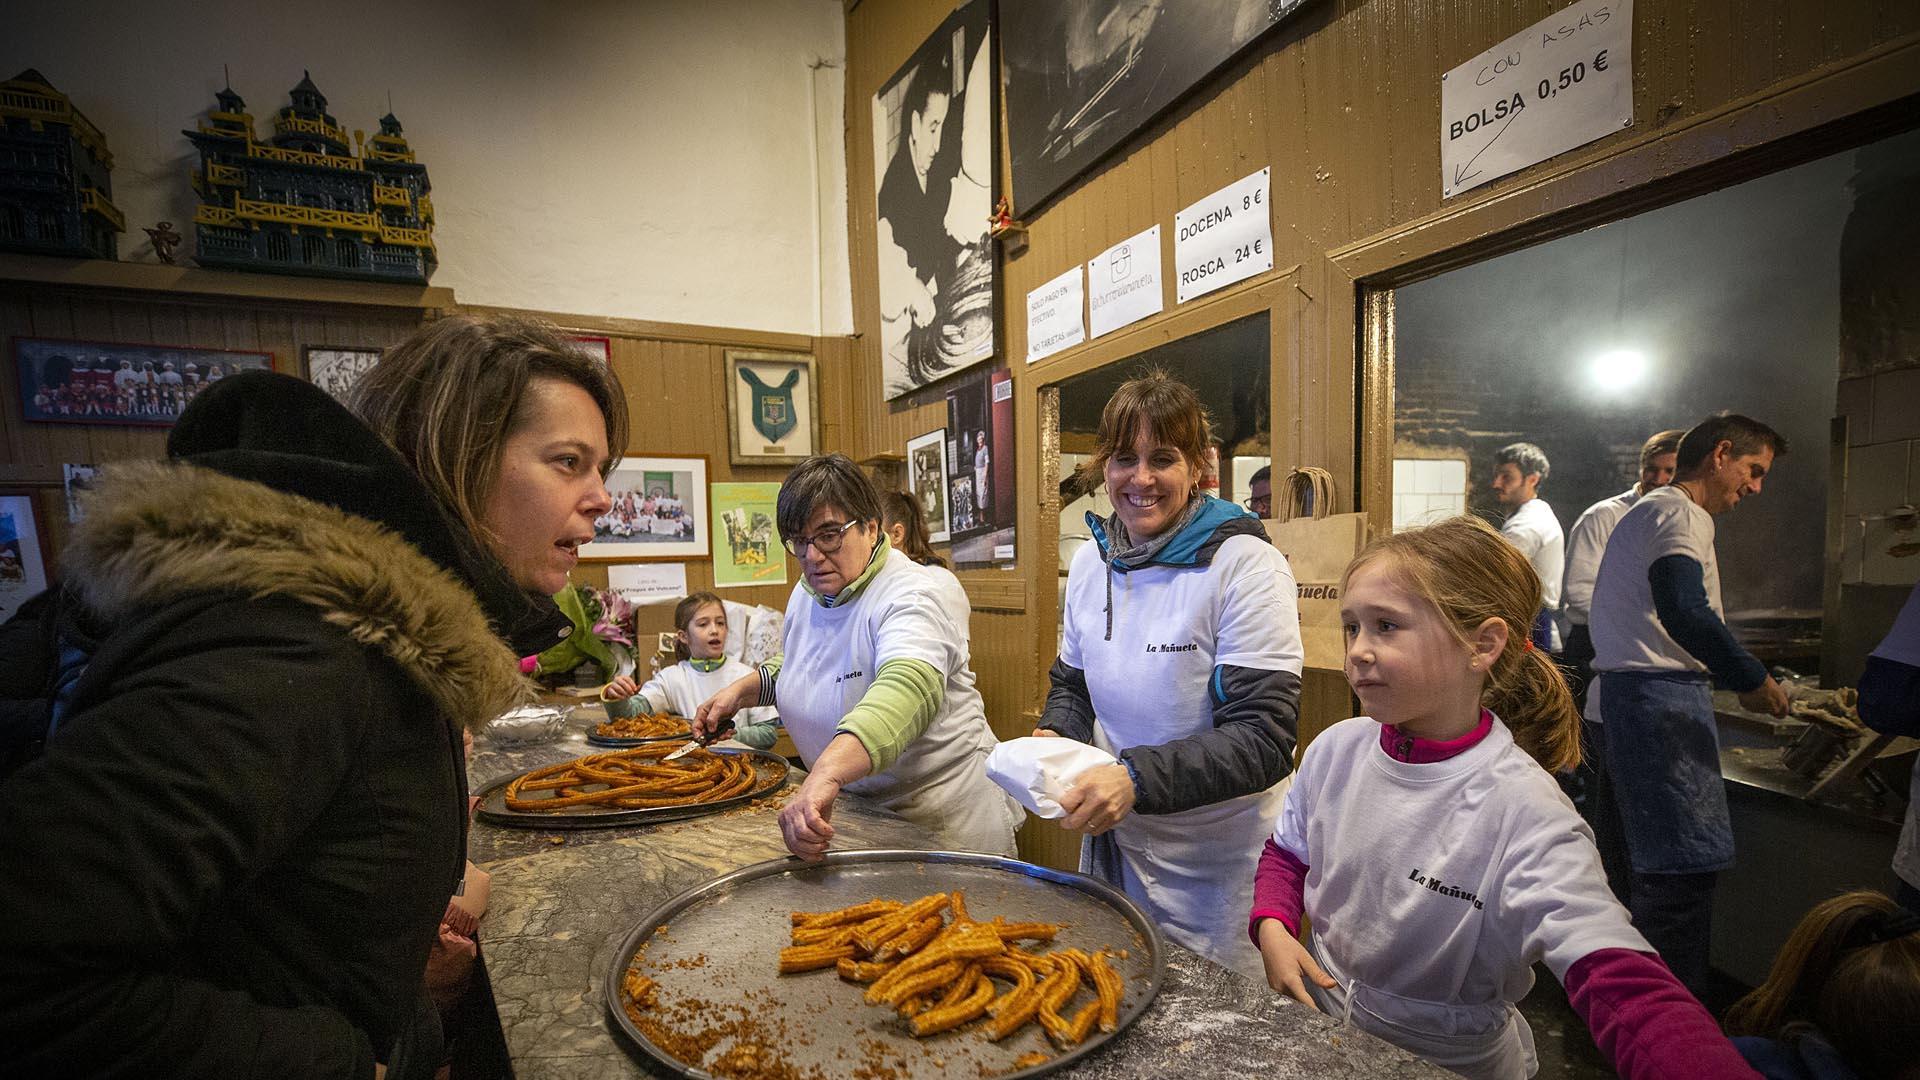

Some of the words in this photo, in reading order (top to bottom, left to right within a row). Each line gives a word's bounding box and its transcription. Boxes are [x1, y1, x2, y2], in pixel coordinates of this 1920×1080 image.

[1475, 52, 1521, 86] CON
[1543, 6, 1611, 48] ASAS
[1450, 92, 1526, 141] BOLSA
[1538, 62, 1586, 100] 0,50
[1592, 49, 1609, 72] €
[1180, 205, 1233, 242] DOCENA
[1243, 195, 1250, 211] 8
[1254, 188, 1262, 204] €
[1182, 256, 1225, 286] ROSCA
[1235, 244, 1250, 264] 24
[1254, 239, 1263, 255] €
[1146, 643, 1158, 653] La
[1159, 643, 1198, 653] Mañueta
[1408, 868, 1426, 886] La
